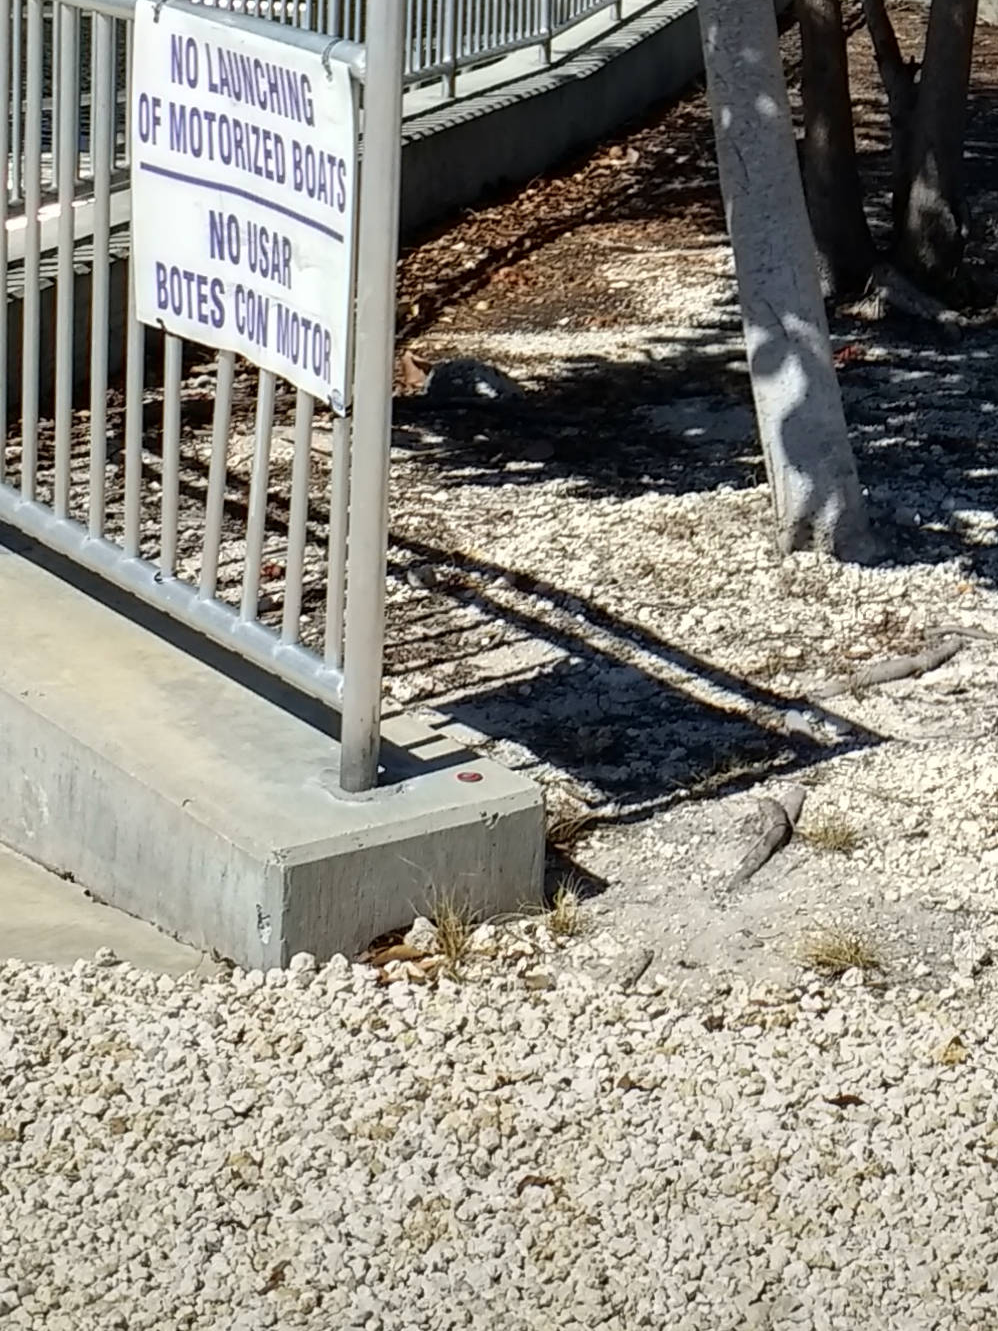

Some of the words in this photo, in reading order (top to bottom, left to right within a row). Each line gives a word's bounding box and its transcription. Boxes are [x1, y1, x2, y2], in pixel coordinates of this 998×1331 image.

[170, 33, 199, 89] NO
[205, 42, 315, 127] LAUNCHING
[138, 92, 162, 144] OF
[169, 101, 287, 186] MOTORIZED
[292, 139, 347, 214] BOATS
[208, 209, 241, 265] NO
[247, 221, 292, 290] USAR
[155, 261, 226, 329] BOTES
[234, 283, 270, 348] CON
[276, 302, 332, 385] MOTOR
